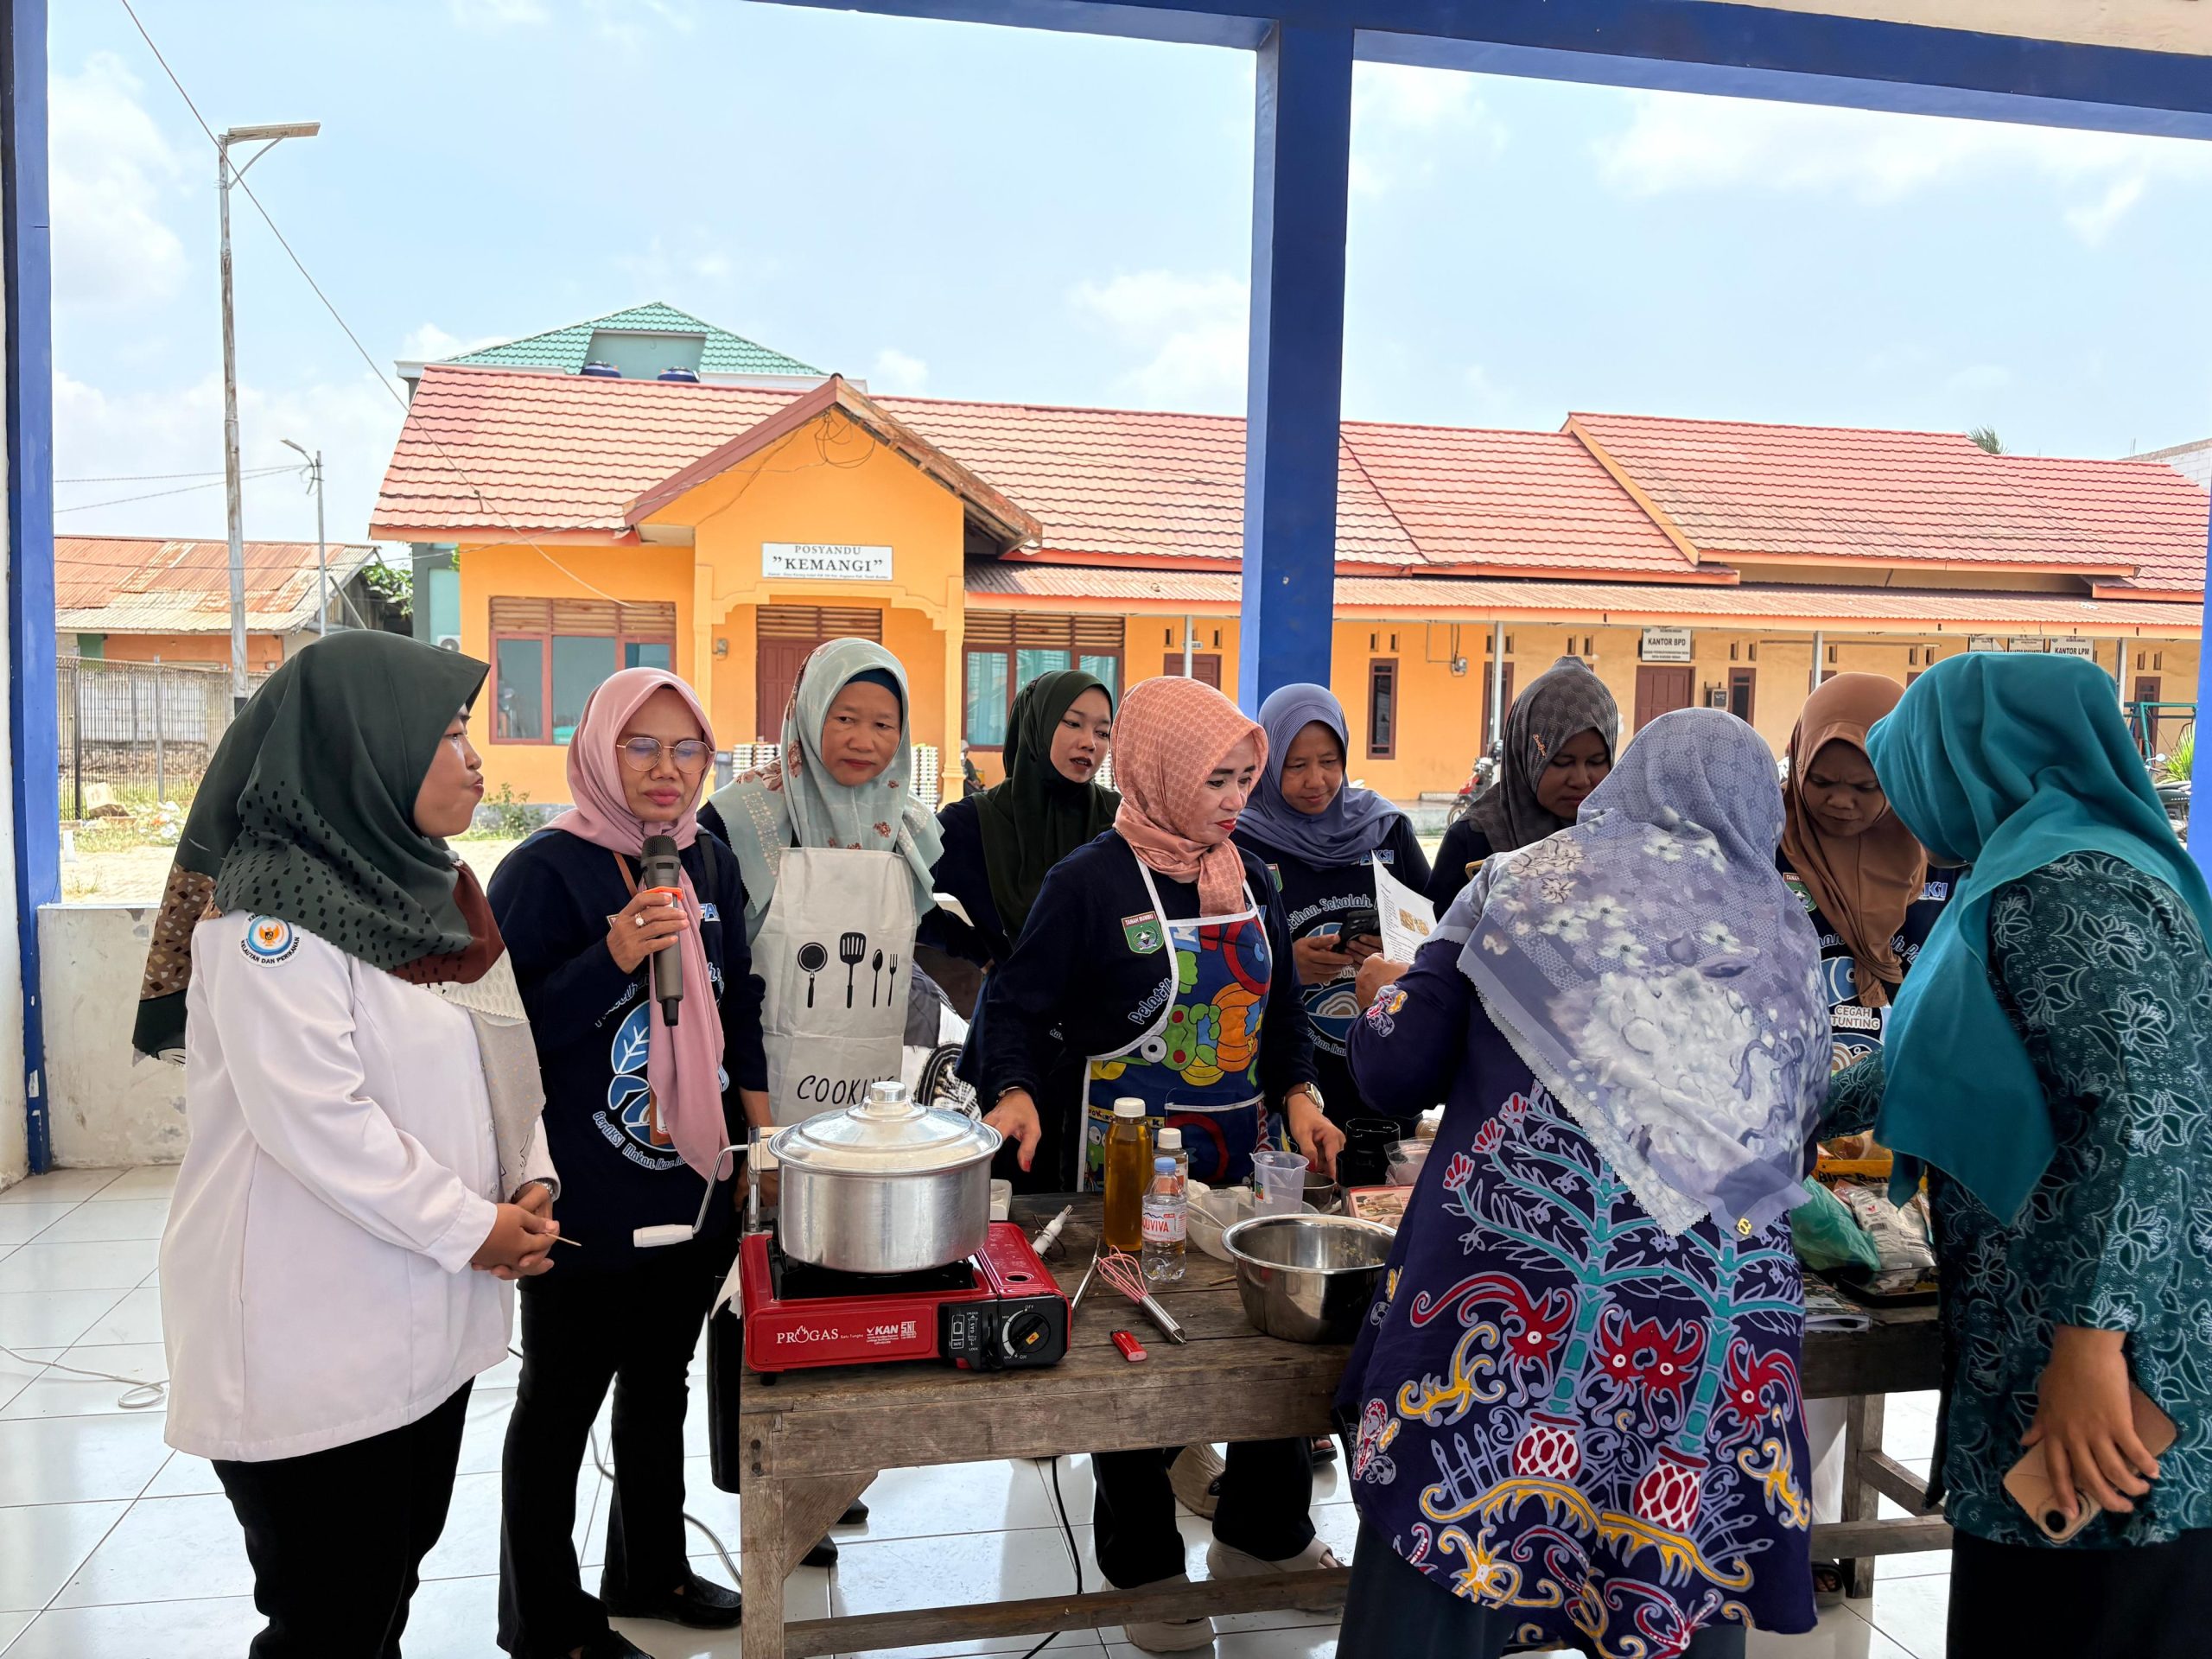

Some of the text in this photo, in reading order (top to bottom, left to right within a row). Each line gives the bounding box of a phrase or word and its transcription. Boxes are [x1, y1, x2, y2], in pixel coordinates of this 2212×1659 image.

[794, 545, 861, 556] POSYANDU
[1674, 638, 1686, 646] BPD
[1319, 893, 1373, 912] Sekolah
[276, 937, 300, 963] PERIKANAN
[1835, 1006, 1872, 1018] CEGAH
[1831, 1016, 1880, 1030] TUNTING
[797, 1075, 895, 1104] COOKI
[622, 1142, 656, 1169] Makan
[777, 1325, 839, 1344] PROGAS
[874, 1325, 899, 1335] KAN
